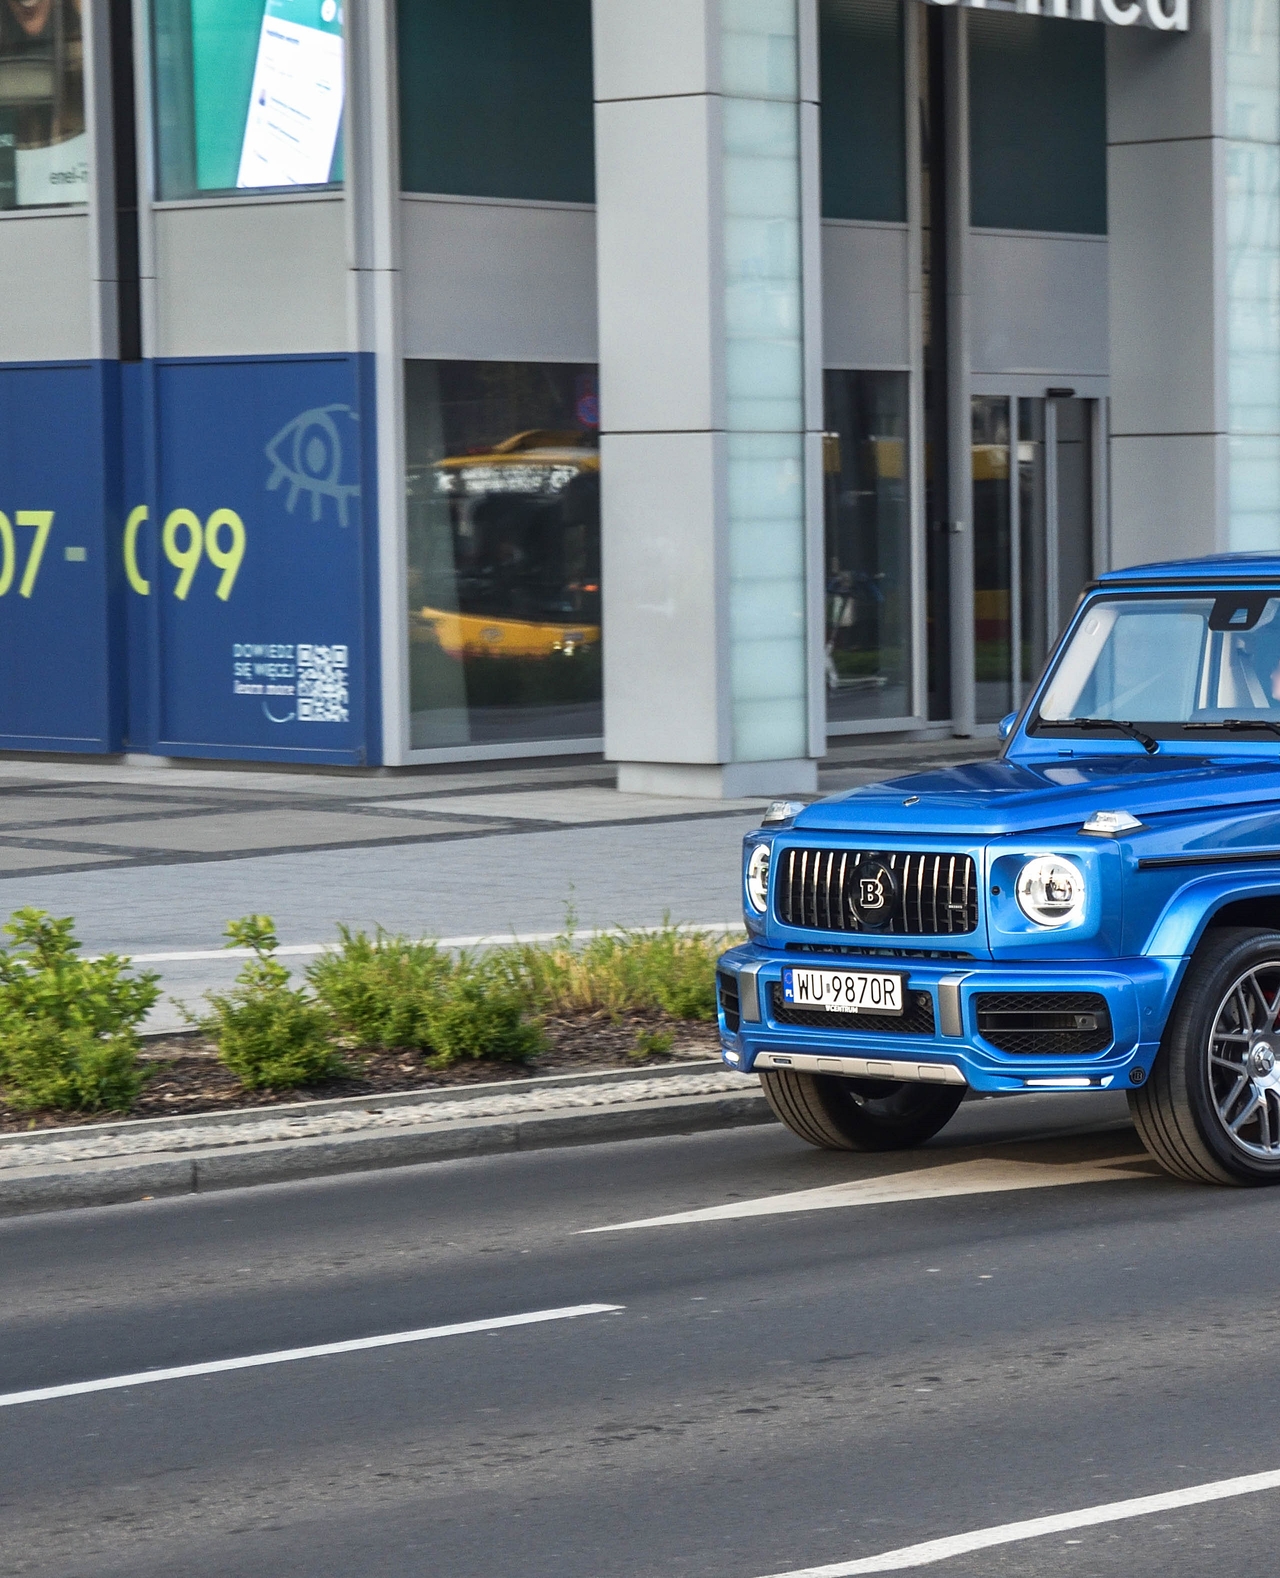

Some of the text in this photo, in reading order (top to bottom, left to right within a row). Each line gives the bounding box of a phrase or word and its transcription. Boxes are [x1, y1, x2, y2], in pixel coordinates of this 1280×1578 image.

[233, 643, 295, 659] DOWIEDZ
[860, 879, 885, 909] B
[785, 988, 794, 998] PL
[797, 973, 896, 1006] WU 9870R
